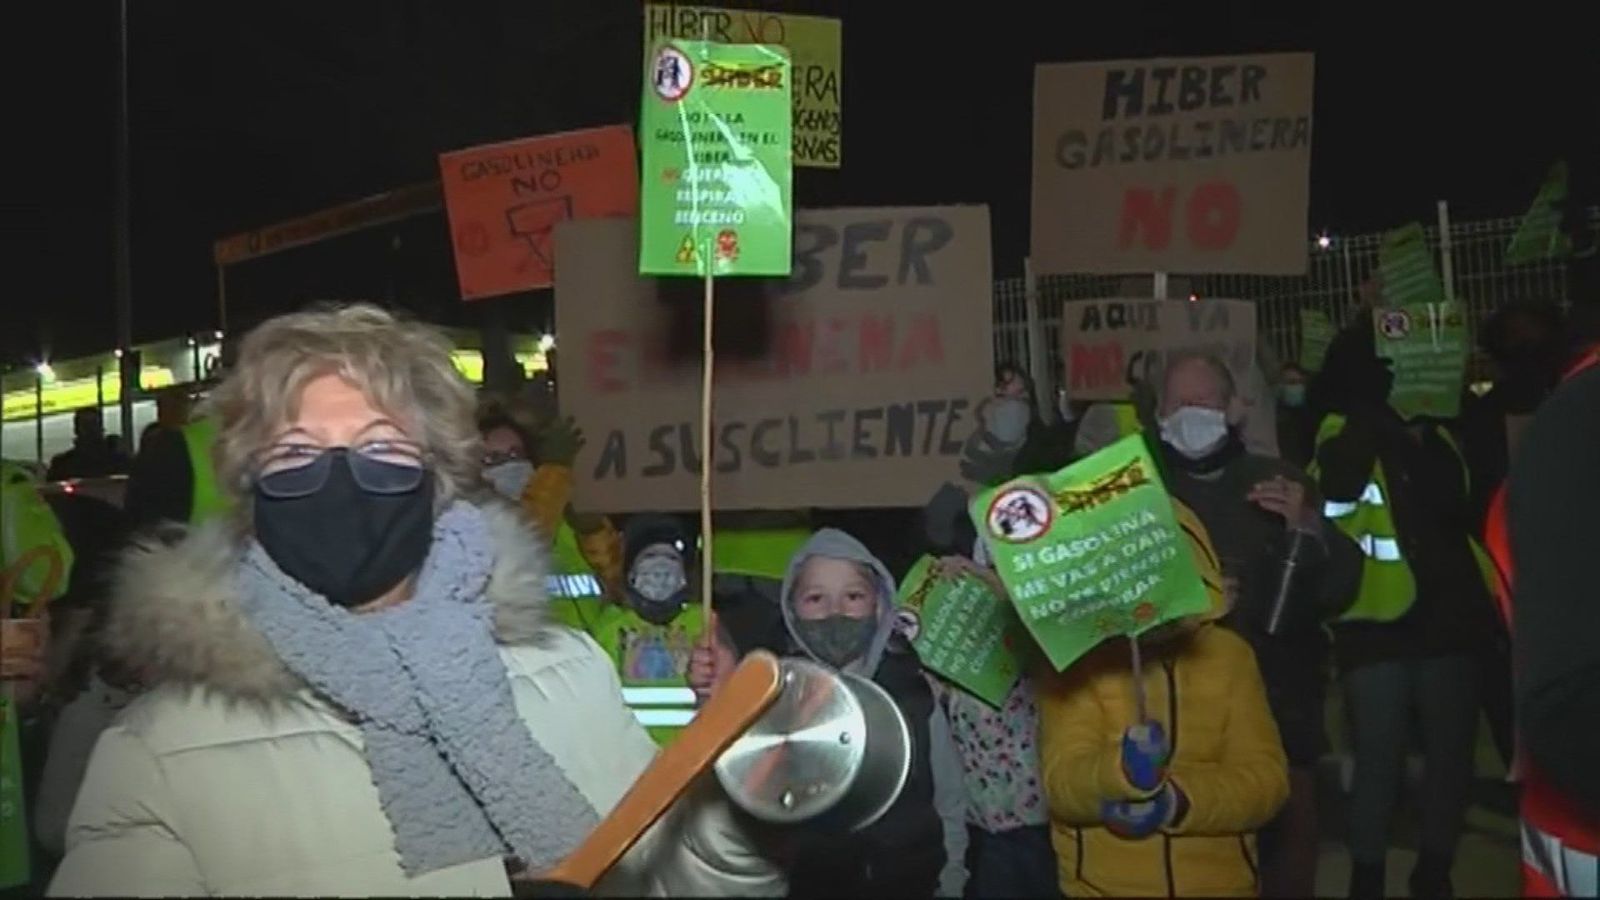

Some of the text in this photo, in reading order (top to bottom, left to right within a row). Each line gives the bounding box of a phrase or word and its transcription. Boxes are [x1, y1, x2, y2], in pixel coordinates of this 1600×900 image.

[742, 11, 786, 45] NO
[1102, 64, 1266, 122] HIBER
[1055, 115, 1310, 170] GASOLINERA
[510, 169, 561, 196] NO
[1118, 180, 1243, 252] NO
[777, 217, 953, 292] BER
[593, 430, 626, 480] A
[1038, 511, 1157, 564] GASOLINA
[1028, 599, 1067, 620] NO
